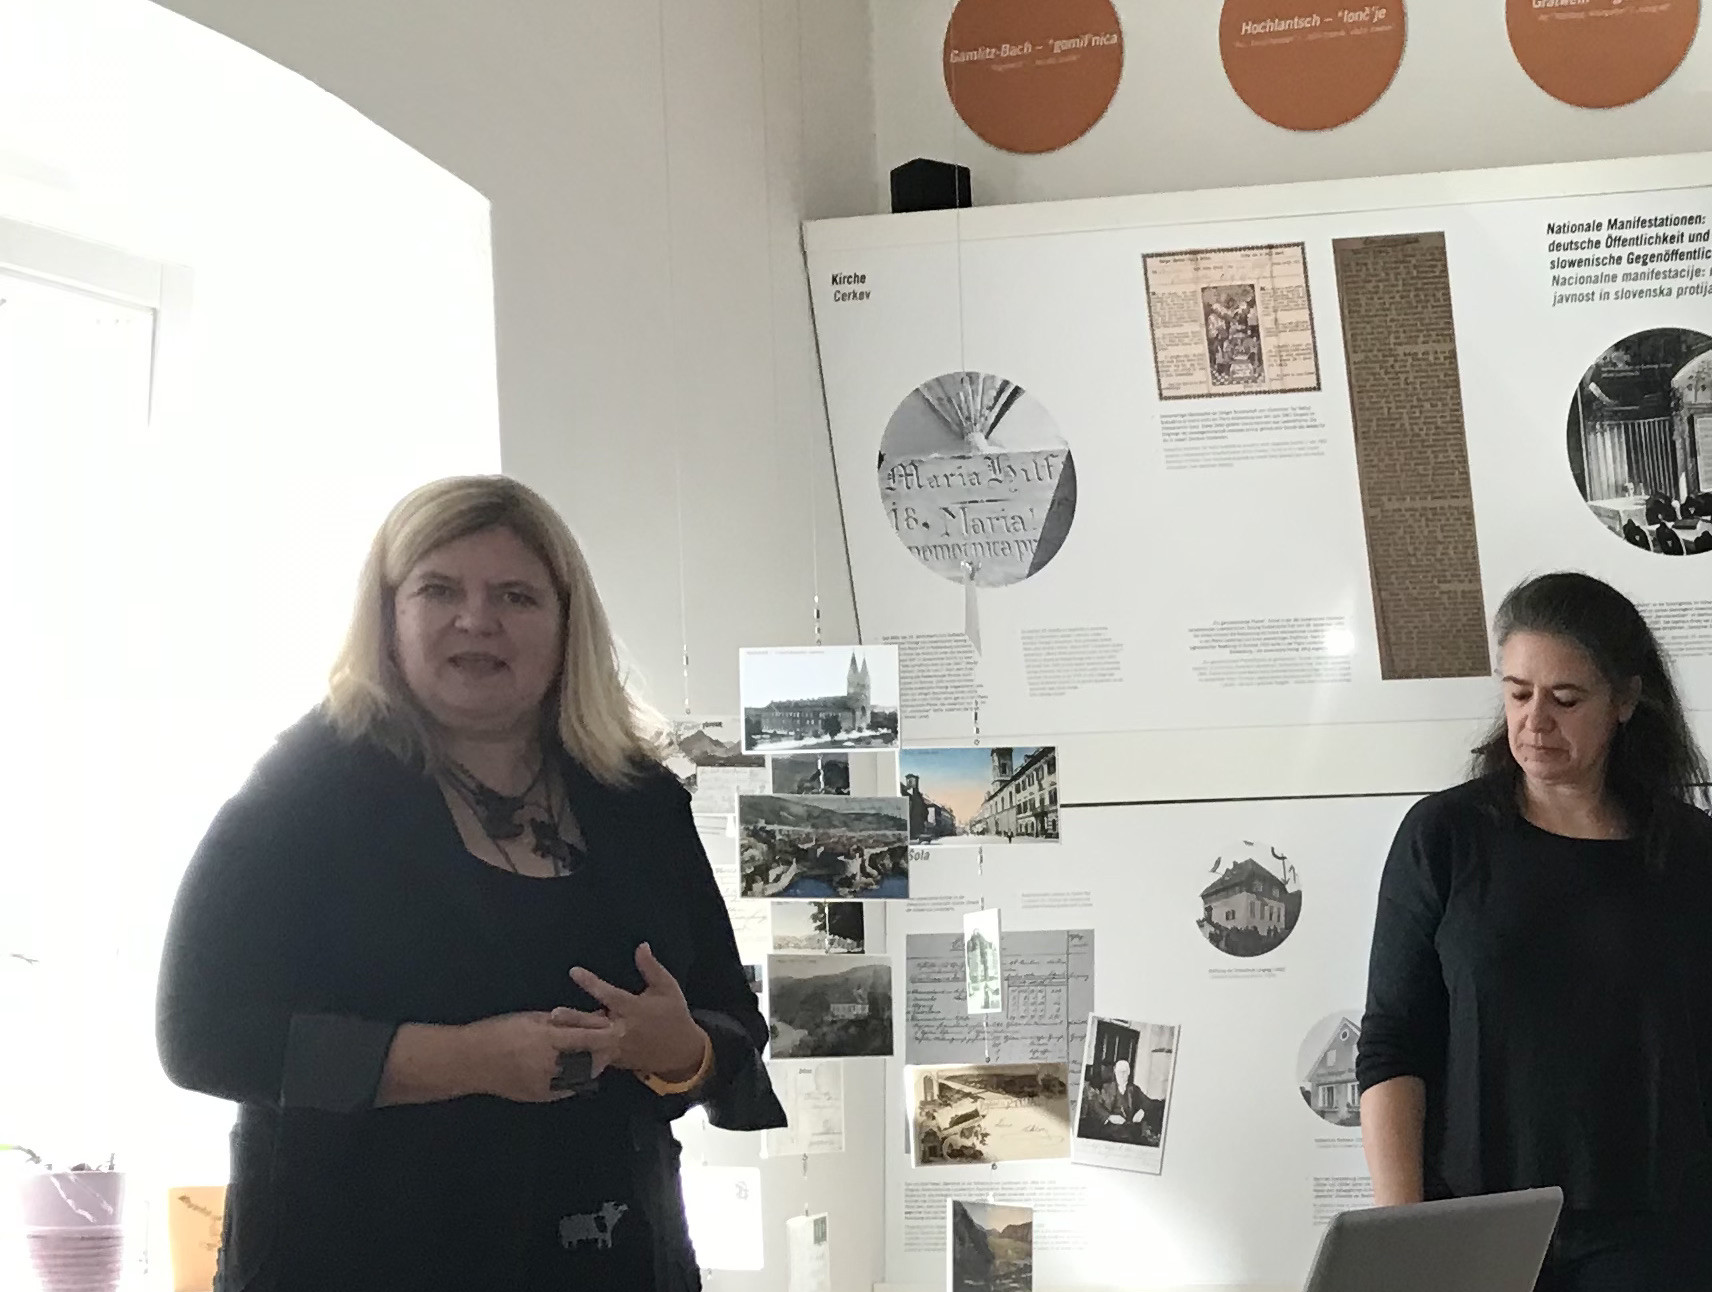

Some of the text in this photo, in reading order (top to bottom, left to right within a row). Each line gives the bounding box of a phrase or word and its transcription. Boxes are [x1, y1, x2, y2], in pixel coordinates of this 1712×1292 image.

[1241, 14, 1320, 35] Hochlantsch
[950, 40, 1032, 63] Gamlitz-Bach
[1546, 214, 1706, 235] Nationale Manifestationen:
[1548, 229, 1710, 252] deutsche Öffentlichkeit und
[1550, 253, 1622, 270] slowenische
[831, 272, 867, 285] Kirche
[1551, 271, 1618, 287] Nacionalne
[1622, 264, 1706, 282] manifestacije:
[1552, 291, 1595, 307] javnost
[1599, 288, 1610, 301] in
[1614, 285, 1672, 301] slovenska
[885, 459, 981, 491] Maria
